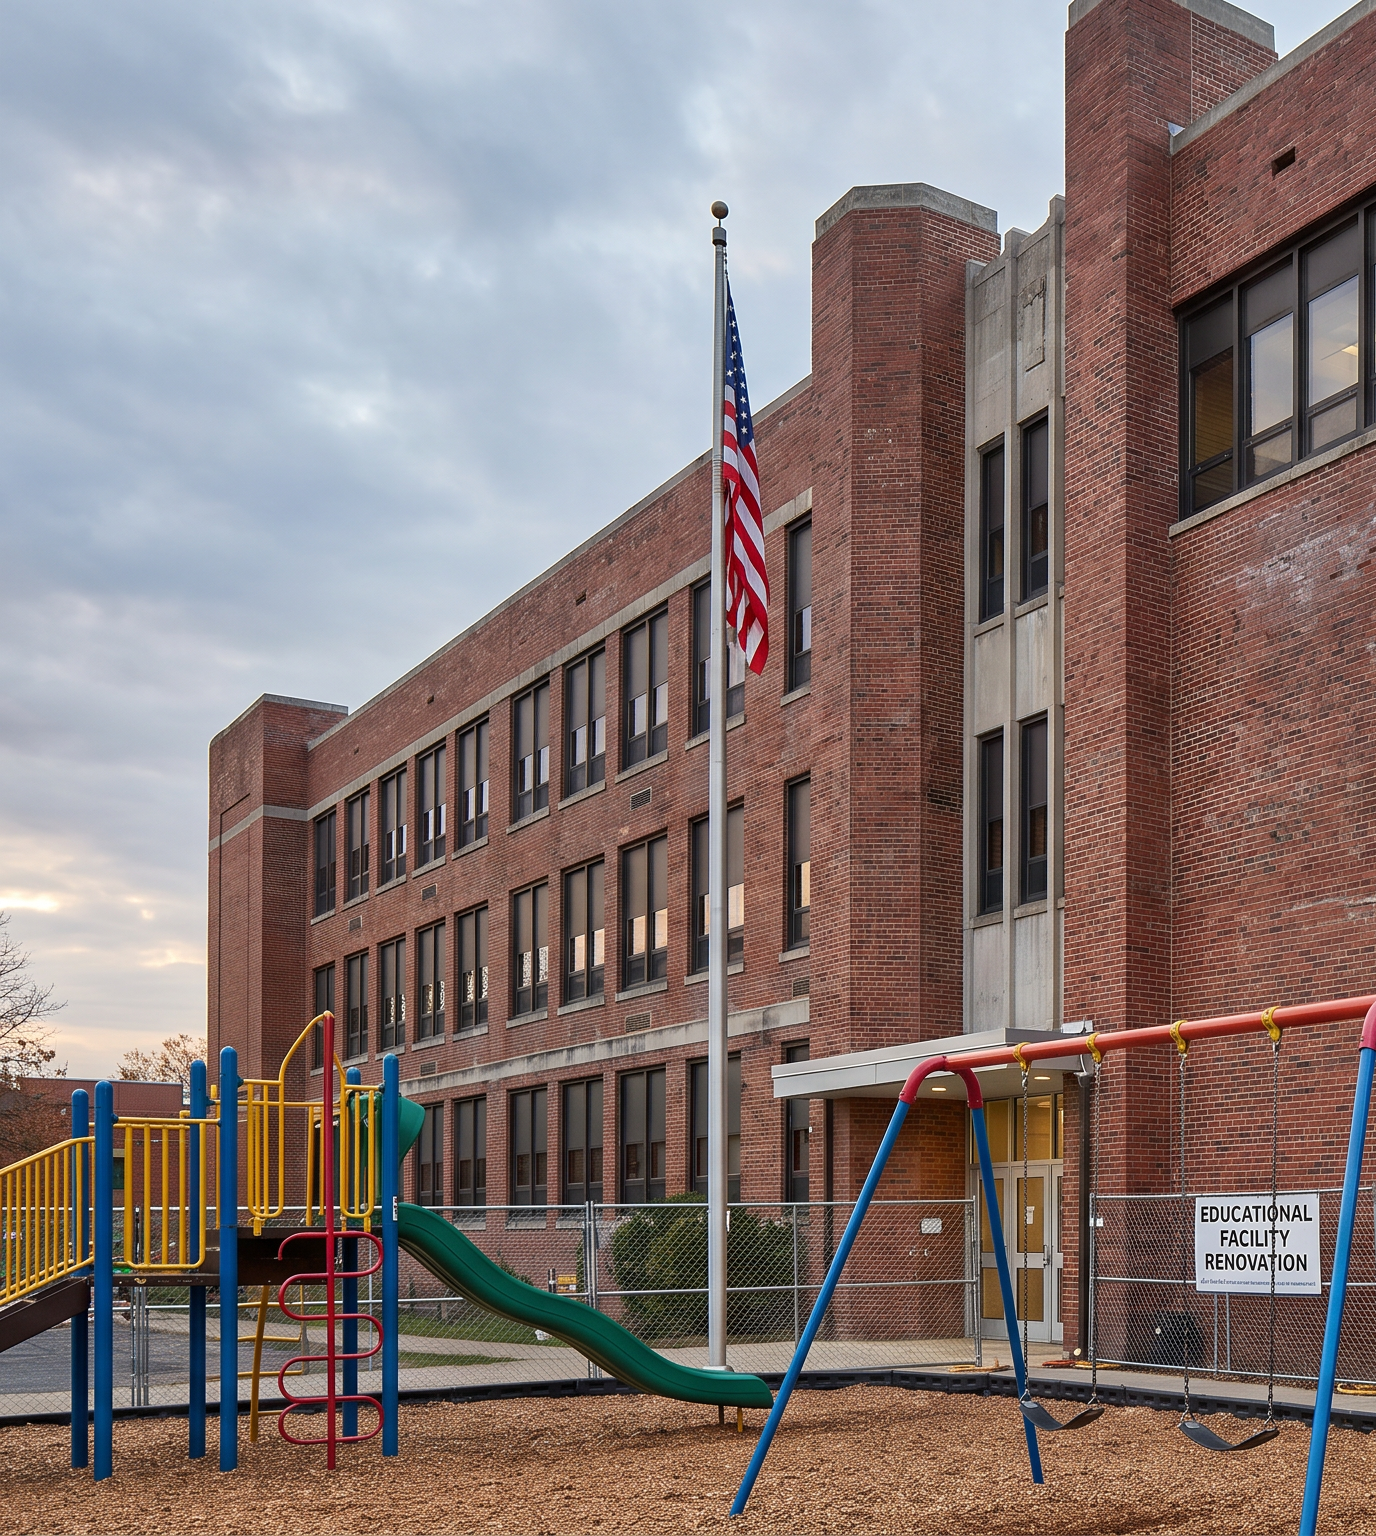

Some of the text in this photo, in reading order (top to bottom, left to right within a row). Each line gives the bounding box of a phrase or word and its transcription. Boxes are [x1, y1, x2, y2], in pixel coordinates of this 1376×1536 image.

[1201, 1205, 1312, 1222] EDUCATIONAL
[1220, 1230, 1290, 1247] FACILITY
[1205, 1253, 1307, 1271] RENOVATION
